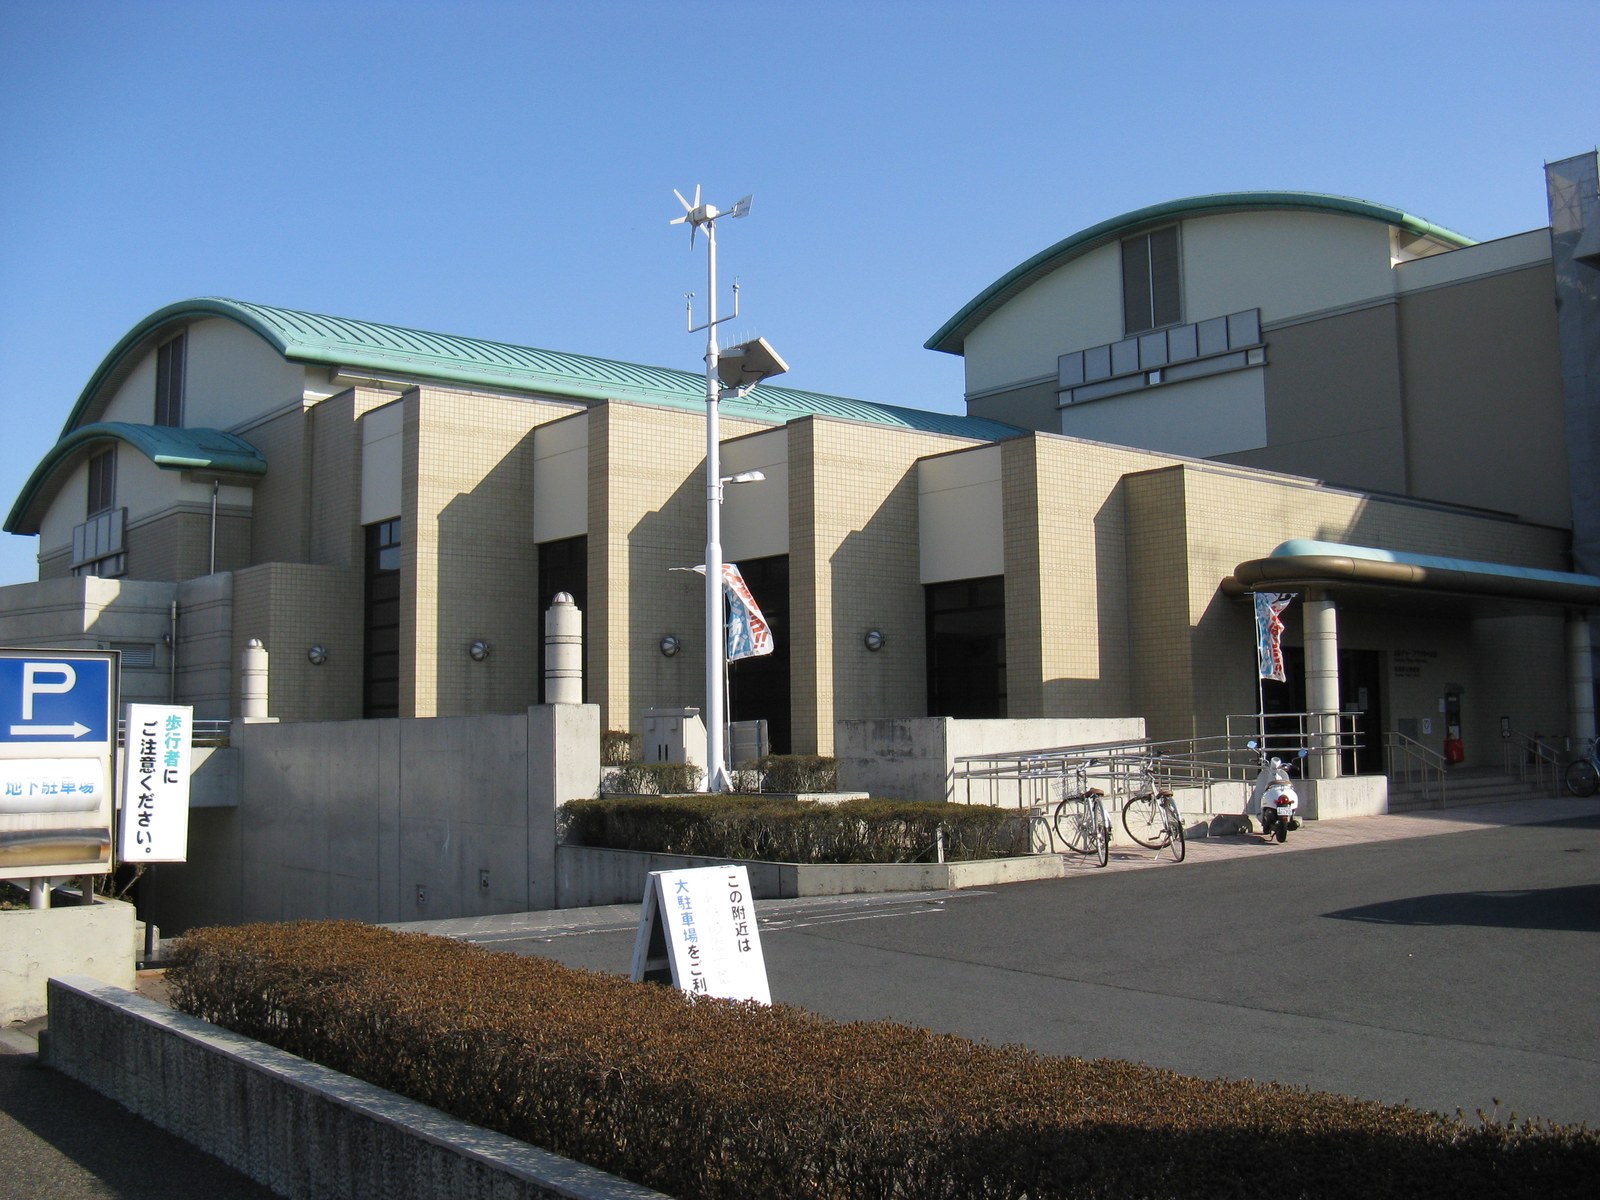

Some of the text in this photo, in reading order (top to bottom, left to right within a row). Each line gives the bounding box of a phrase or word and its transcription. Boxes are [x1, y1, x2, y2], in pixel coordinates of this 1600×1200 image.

[23, 663, 76, 719] P
[163, 714, 182, 784] 歩行者に
[136, 720, 159, 854] ご注意ください。
[728, 875, 752, 953] この附近は
